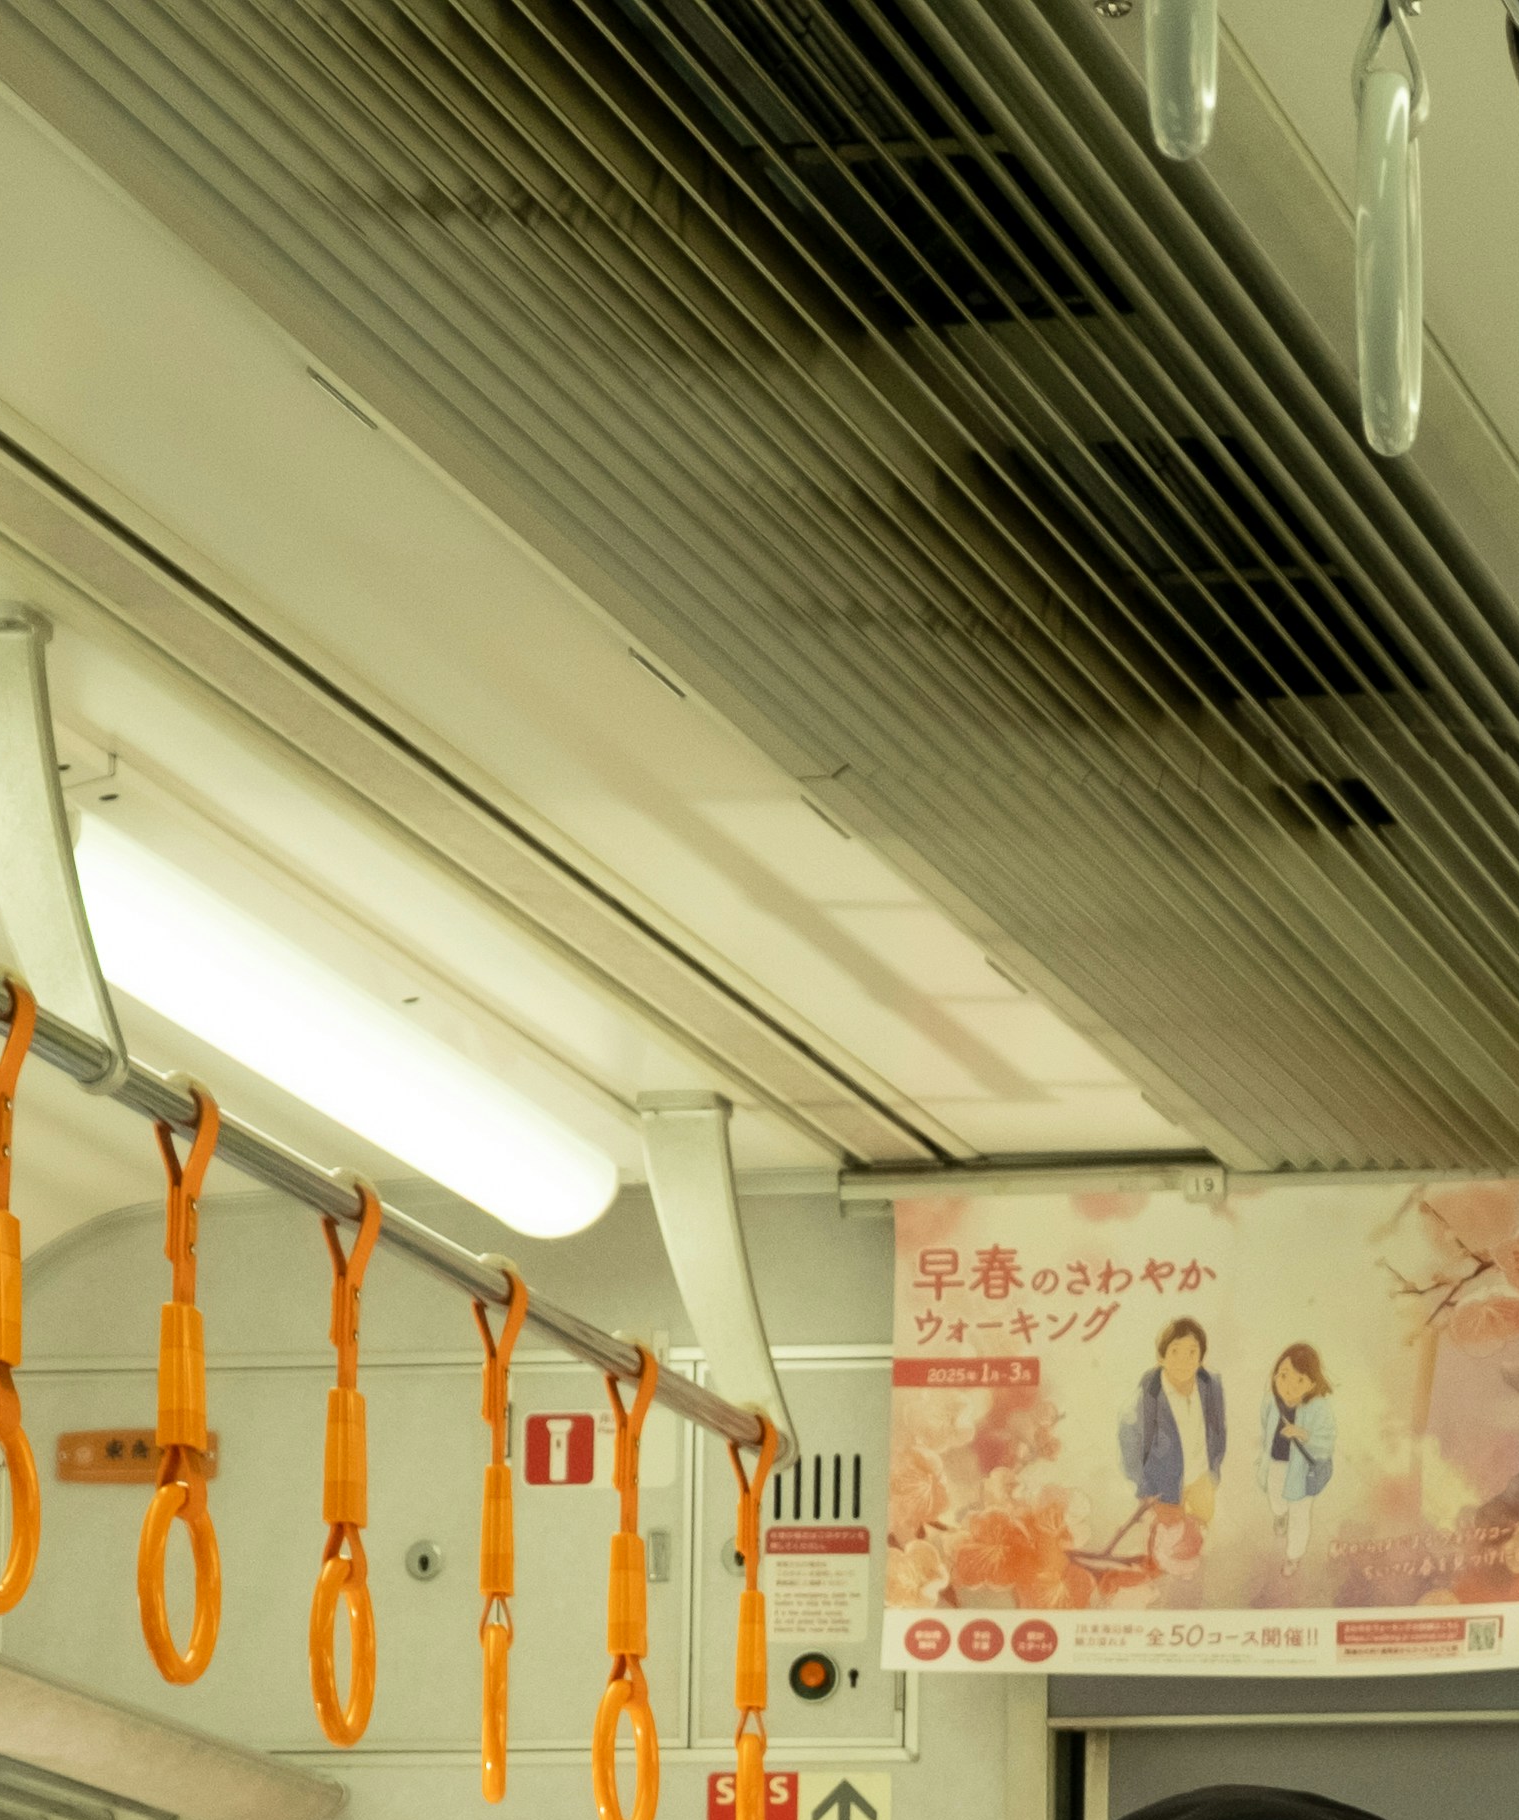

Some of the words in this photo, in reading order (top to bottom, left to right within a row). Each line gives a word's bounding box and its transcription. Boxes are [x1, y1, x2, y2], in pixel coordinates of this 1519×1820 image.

[1195, 1178, 1214, 1192] 19
[912, 1243, 1217, 1301] 早春のさわやか
[913, 1300, 1122, 1345] ウォーキング
[1146, 1623, 1319, 1648] 全50コース開催!!
[716, 1776, 789, 1805] SS
